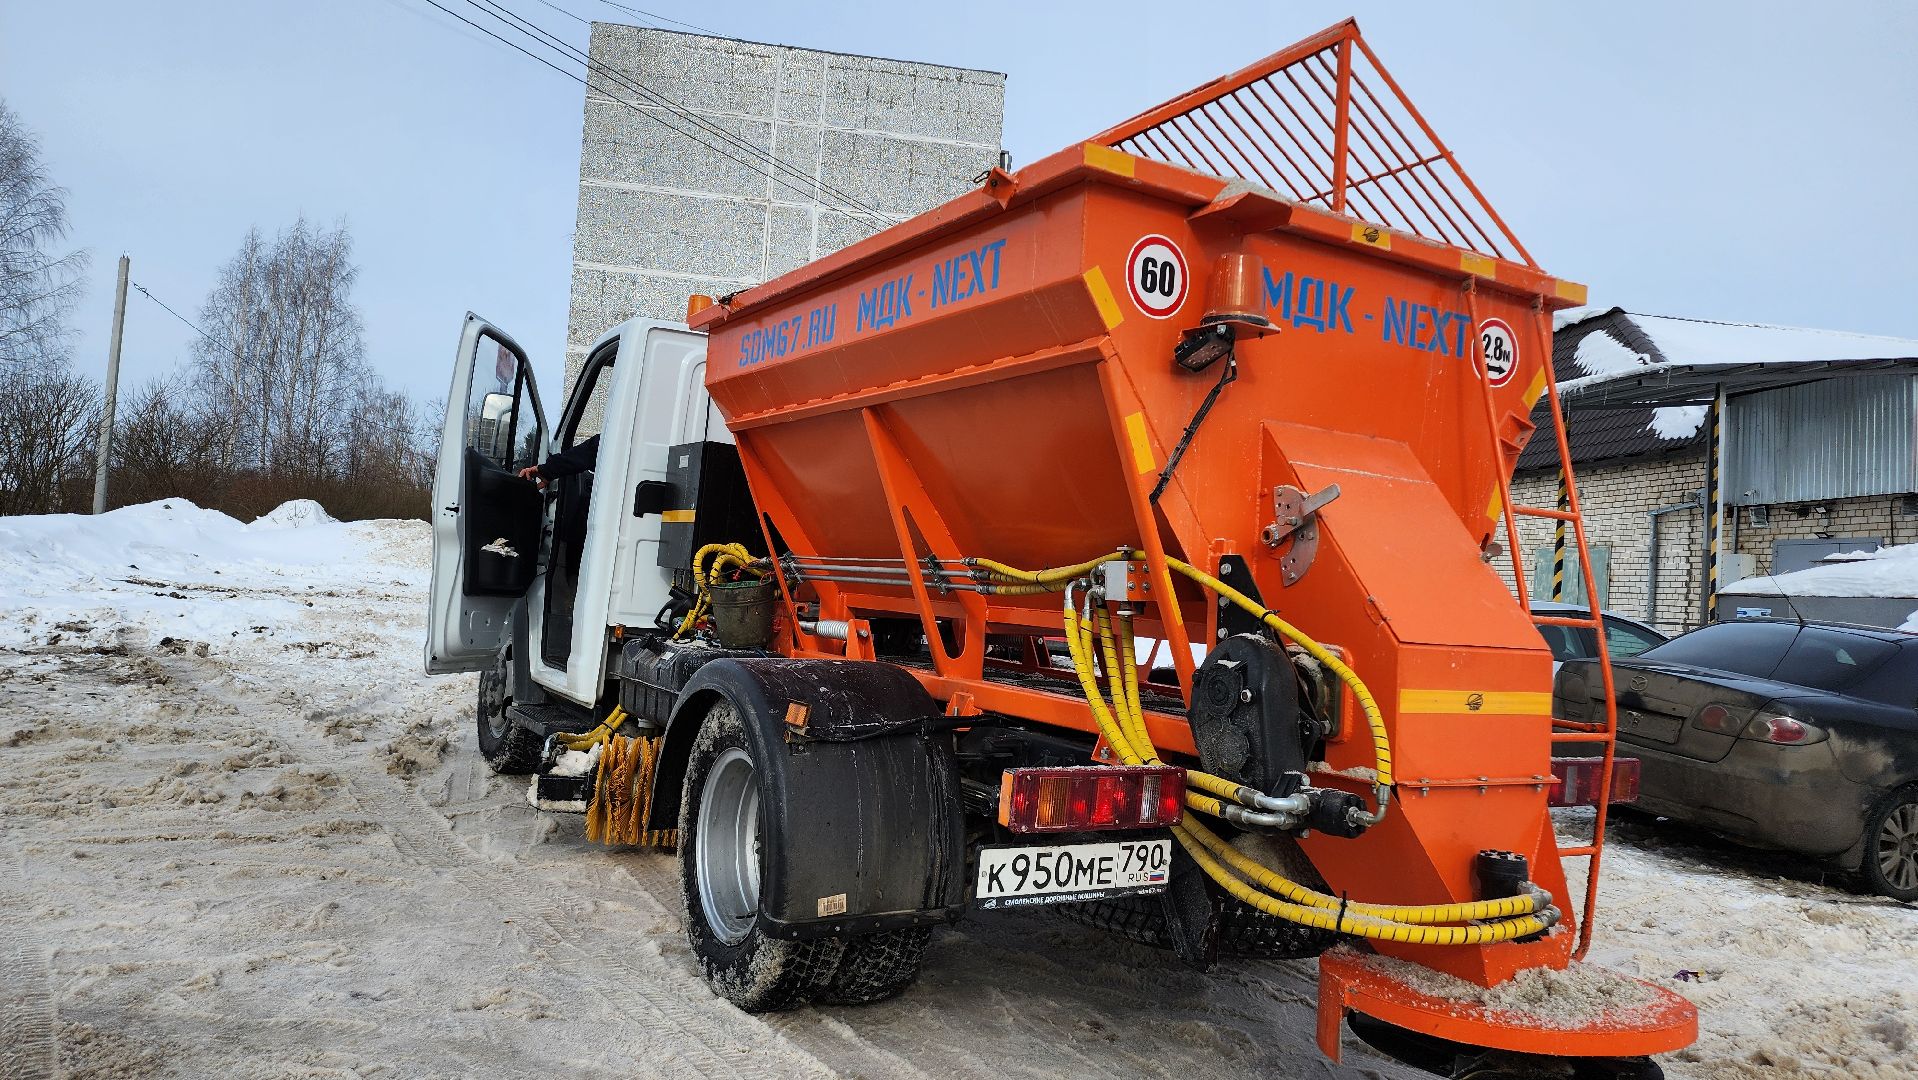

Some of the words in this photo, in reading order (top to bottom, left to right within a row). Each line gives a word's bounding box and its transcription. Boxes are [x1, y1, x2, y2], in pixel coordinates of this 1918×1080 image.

[1141, 257, 1175, 297] 60
[739, 304, 838, 368] SDM67.RU
[856, 273, 914, 332] МДК
[930, 239, 1007, 309] NEXT
[1263, 266, 1356, 334] МДК
[1382, 296, 1472, 358] NEXT
[987, 851, 1115, 894] К950МЕ
[1121, 843, 1164, 873] 790
[1128, 872, 1149, 883] RUS
